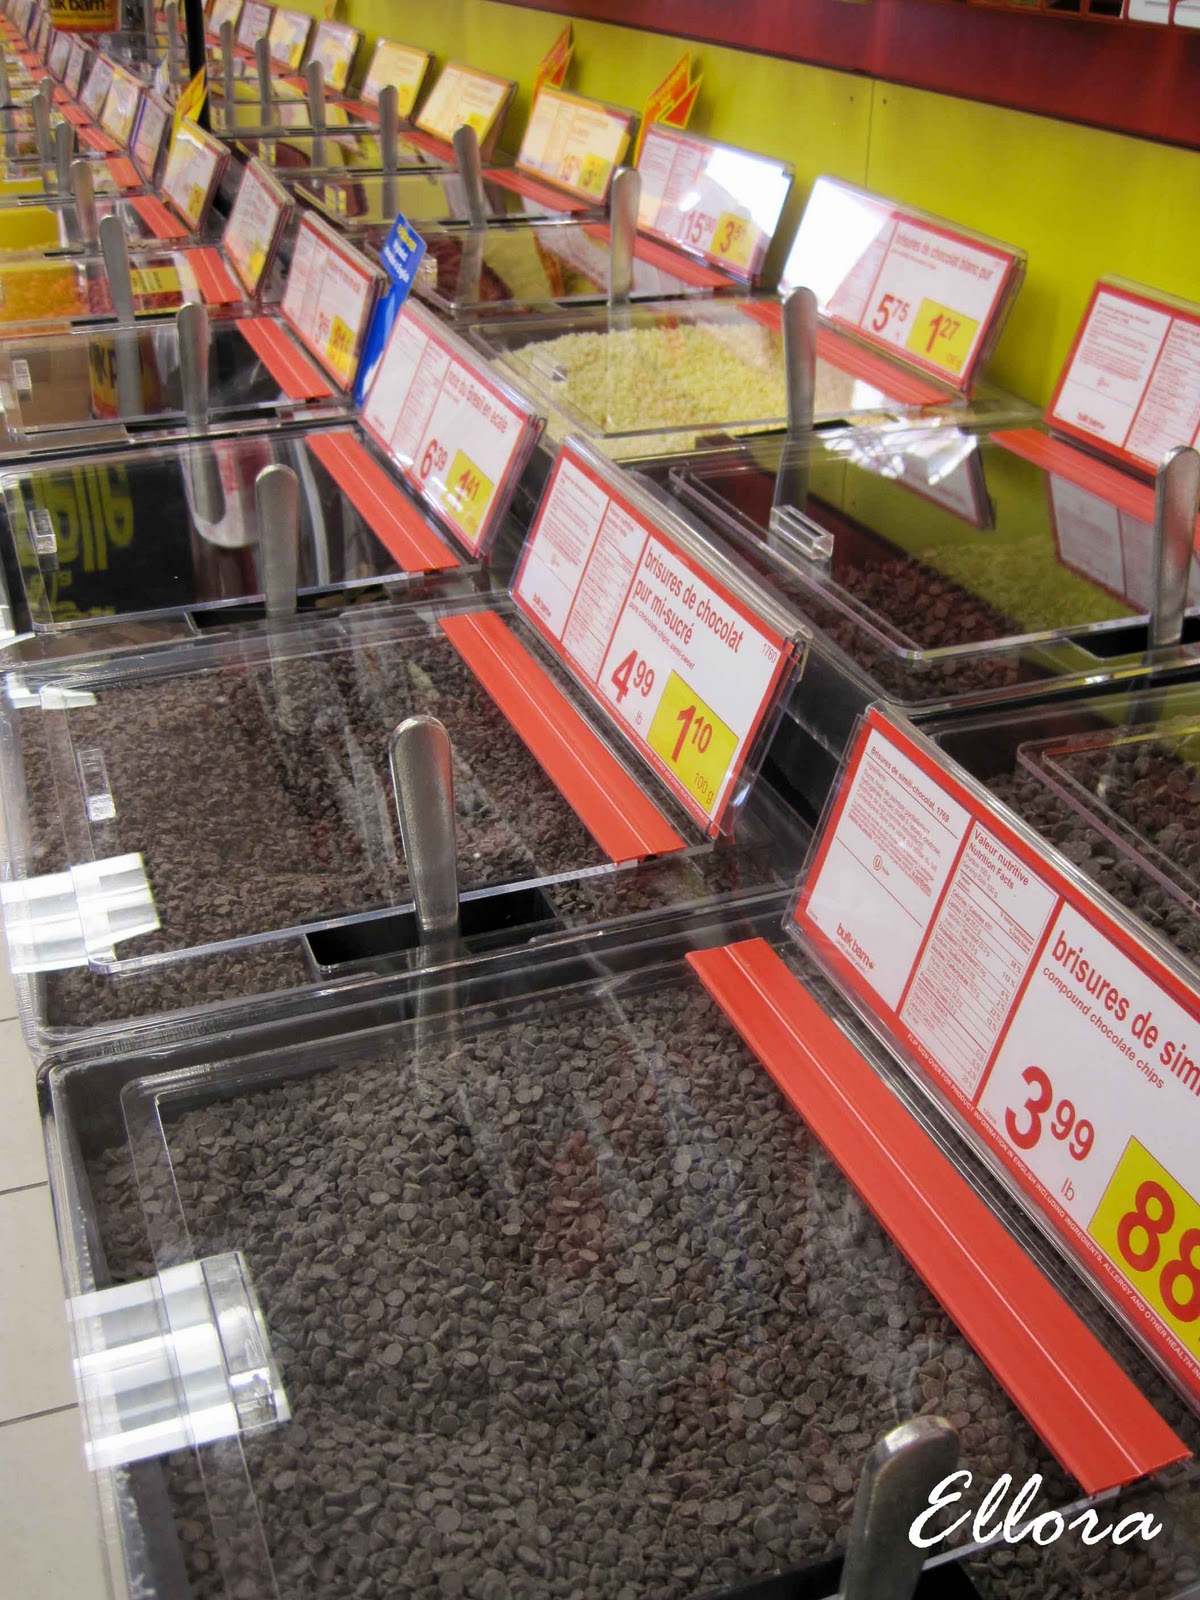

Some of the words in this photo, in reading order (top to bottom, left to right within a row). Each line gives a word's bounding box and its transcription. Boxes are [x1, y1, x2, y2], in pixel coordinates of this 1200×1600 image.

[632, 579, 653, 604] pur
[650, 595, 692, 645] mi-sucré
[644, 546, 683, 597] brisures
[682, 584, 697, 610] de
[696, 598, 744, 654] chocolat
[762, 643, 778, 664] 1760
[694, 772, 709, 794] 100
[706, 790, 714, 805] g
[936, 807, 950, 823] 1769
[969, 842, 996, 872] Nutrition
[995, 867, 1014, 889] Facts
[975, 829, 998, 857] Valeur
[997, 853, 1029, 886] nutritive
[836, 922, 853, 948] bulk
[851, 939, 870, 967] barn
[1051, 930, 1130, 1022] brisures
[1131, 1011, 1159, 1049] de
[1043, 966, 1091, 1016] compound
[1090, 1011, 1136, 1061] chocolate
[1136, 1058, 1164, 1089] chips
[906, 1032, 918, 1047] FLIP
[916, 1043, 929, 1060] SIGN
[927, 1056, 942, 1075] OVER
[940, 1071, 952, 1086] FOR
[949, 1082, 974, 1112] PRODUCT
[972, 1109, 1008, 1152] INFORMATION
[1005, 1148, 1014, 1159] IN
[1012, 1155, 1037, 1185] ENGLISH
[1034, 1181, 1065, 1219] INCLUDING
[1063, 1215, 1104, 1265] INGREDIENTS,
[1102, 1260, 1132, 1297] ALLERGY
[1129, 1293, 1145, 1313] AND
[1143, 1309, 1167, 1338] OTHER
[1165, 1334, 1193, 1369] HEALTH
[1061, 1177, 1075, 1201] lb
